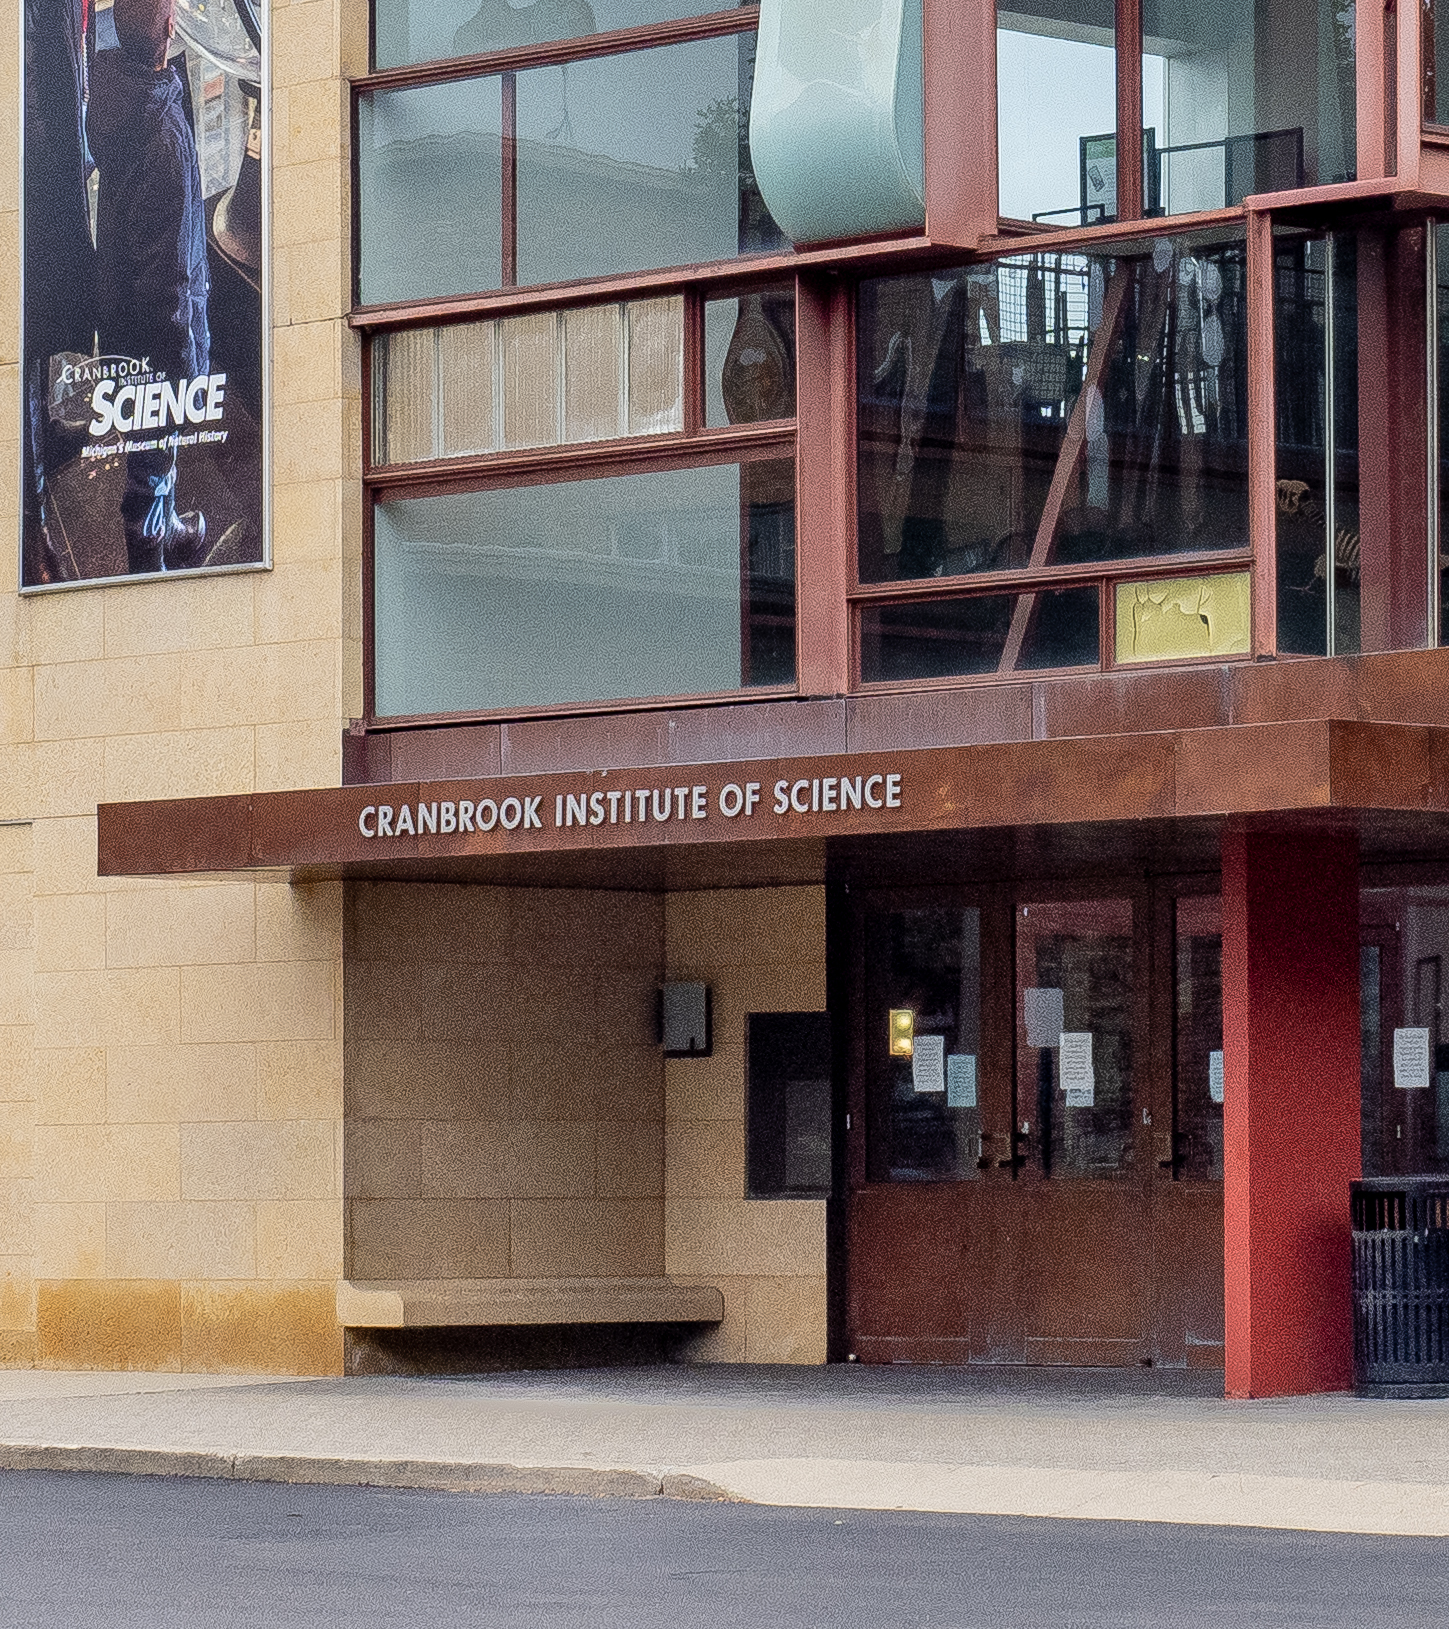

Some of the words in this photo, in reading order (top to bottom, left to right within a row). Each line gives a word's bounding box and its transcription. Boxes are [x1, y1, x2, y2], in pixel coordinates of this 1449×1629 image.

[56, 355, 152, 384] CRANBROOK
[118, 373, 154, 387] INSTITUTE
[155, 371, 167, 382] OF
[88, 373, 227, 436] SCIENCE
[81, 440, 124, 458] Michigan's
[125, 438, 158, 453] Museum
[158, 434, 170, 451] of
[168, 431, 198, 447] Natural
[198, 430, 229, 444] History
[358, 795, 543, 838] CRANBROOK
[554, 785, 707, 828] INSTITUTE
[718, 781, 761, 817] OF
[772, 773, 902, 815] SCIENCE
